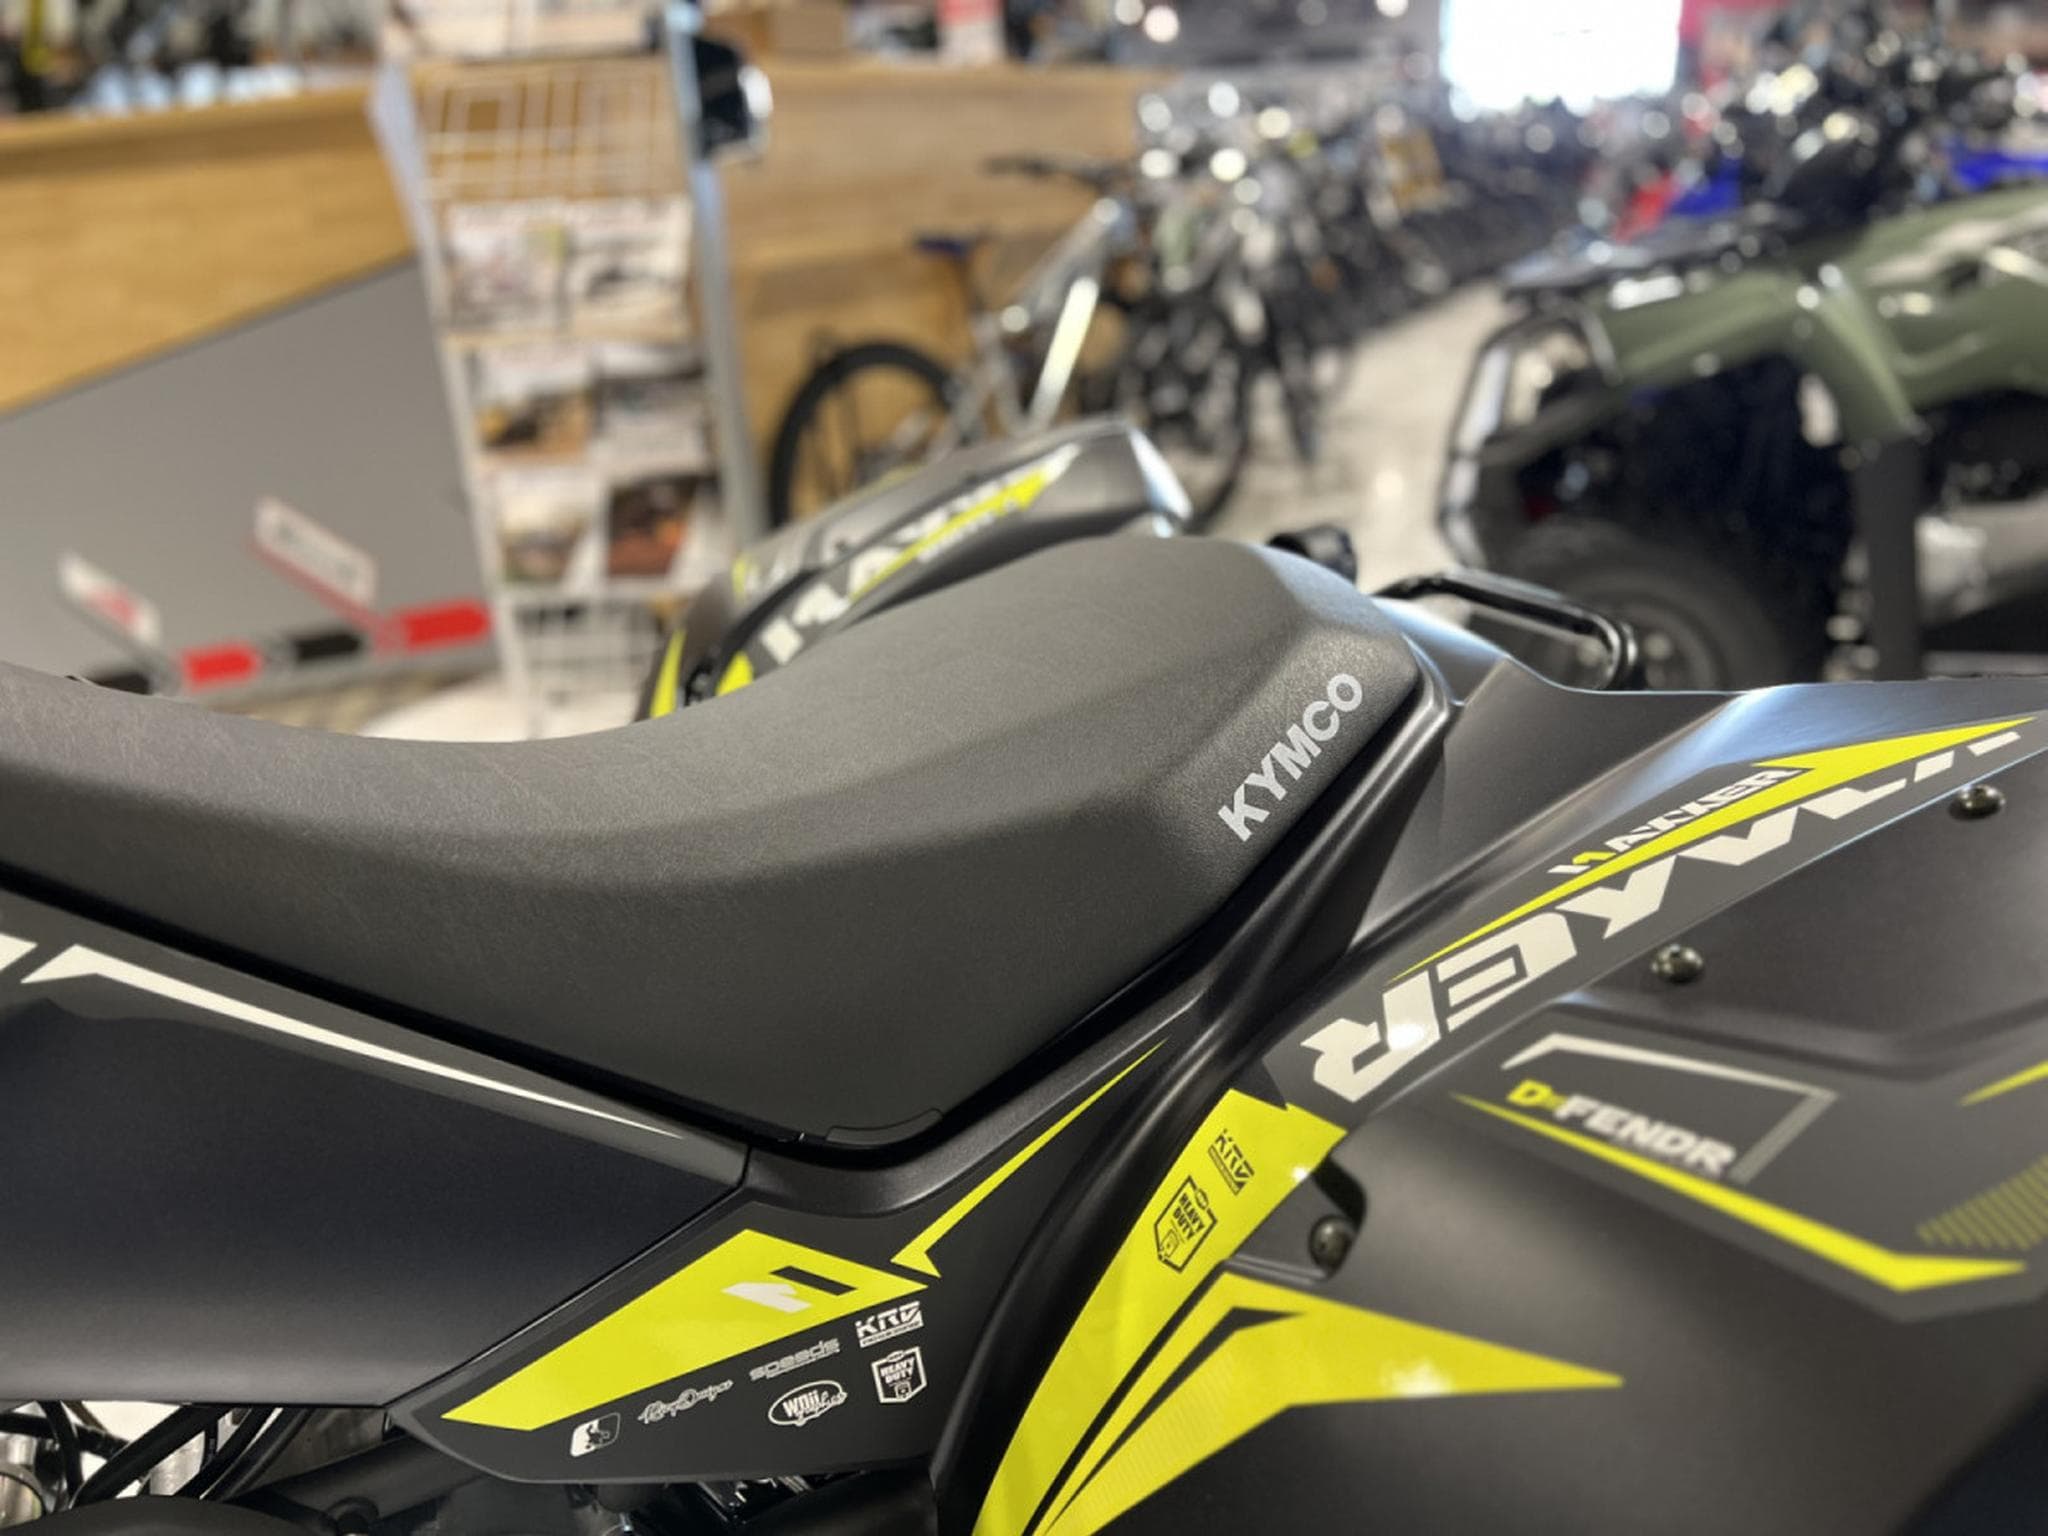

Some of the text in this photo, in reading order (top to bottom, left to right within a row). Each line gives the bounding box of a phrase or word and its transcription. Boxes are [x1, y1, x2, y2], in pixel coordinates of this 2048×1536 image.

[1217, 673, 1363, 842] KYMCO
[1172, 1207, 1198, 1241] DUTY
[1178, 1193, 1206, 1234] HEAVY
[880, 1356, 915, 1379] HEAVY
[884, 1367, 914, 1385] DUTY
